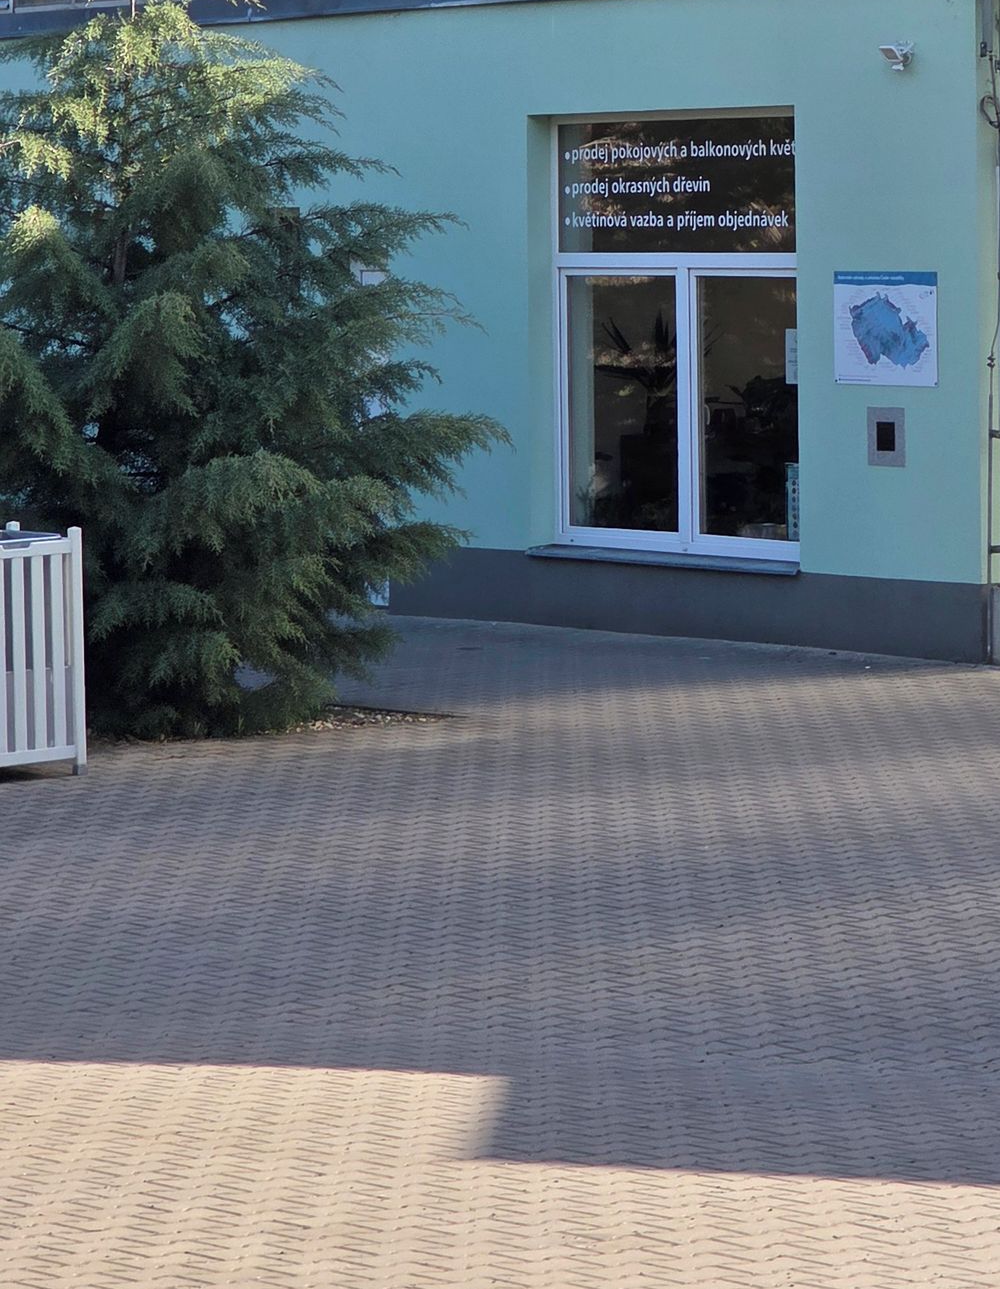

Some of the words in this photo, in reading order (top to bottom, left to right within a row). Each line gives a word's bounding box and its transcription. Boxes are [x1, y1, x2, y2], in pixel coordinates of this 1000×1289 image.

[571, 144, 609, 165] prodej
[611, 142, 678, 163] pokojových
[680, 144, 688, 157] a
[690, 139, 767, 161] balkonových
[571, 177, 610, 198] prodej
[611, 176, 670, 197] okrasných
[673, 175, 711, 193] dřevin
[572, 211, 628, 228] květinová
[630, 212, 664, 227] vazba
[666, 215, 674, 227] a
[677, 211, 715, 231] příjem
[718, 210, 789, 231] objednávek
